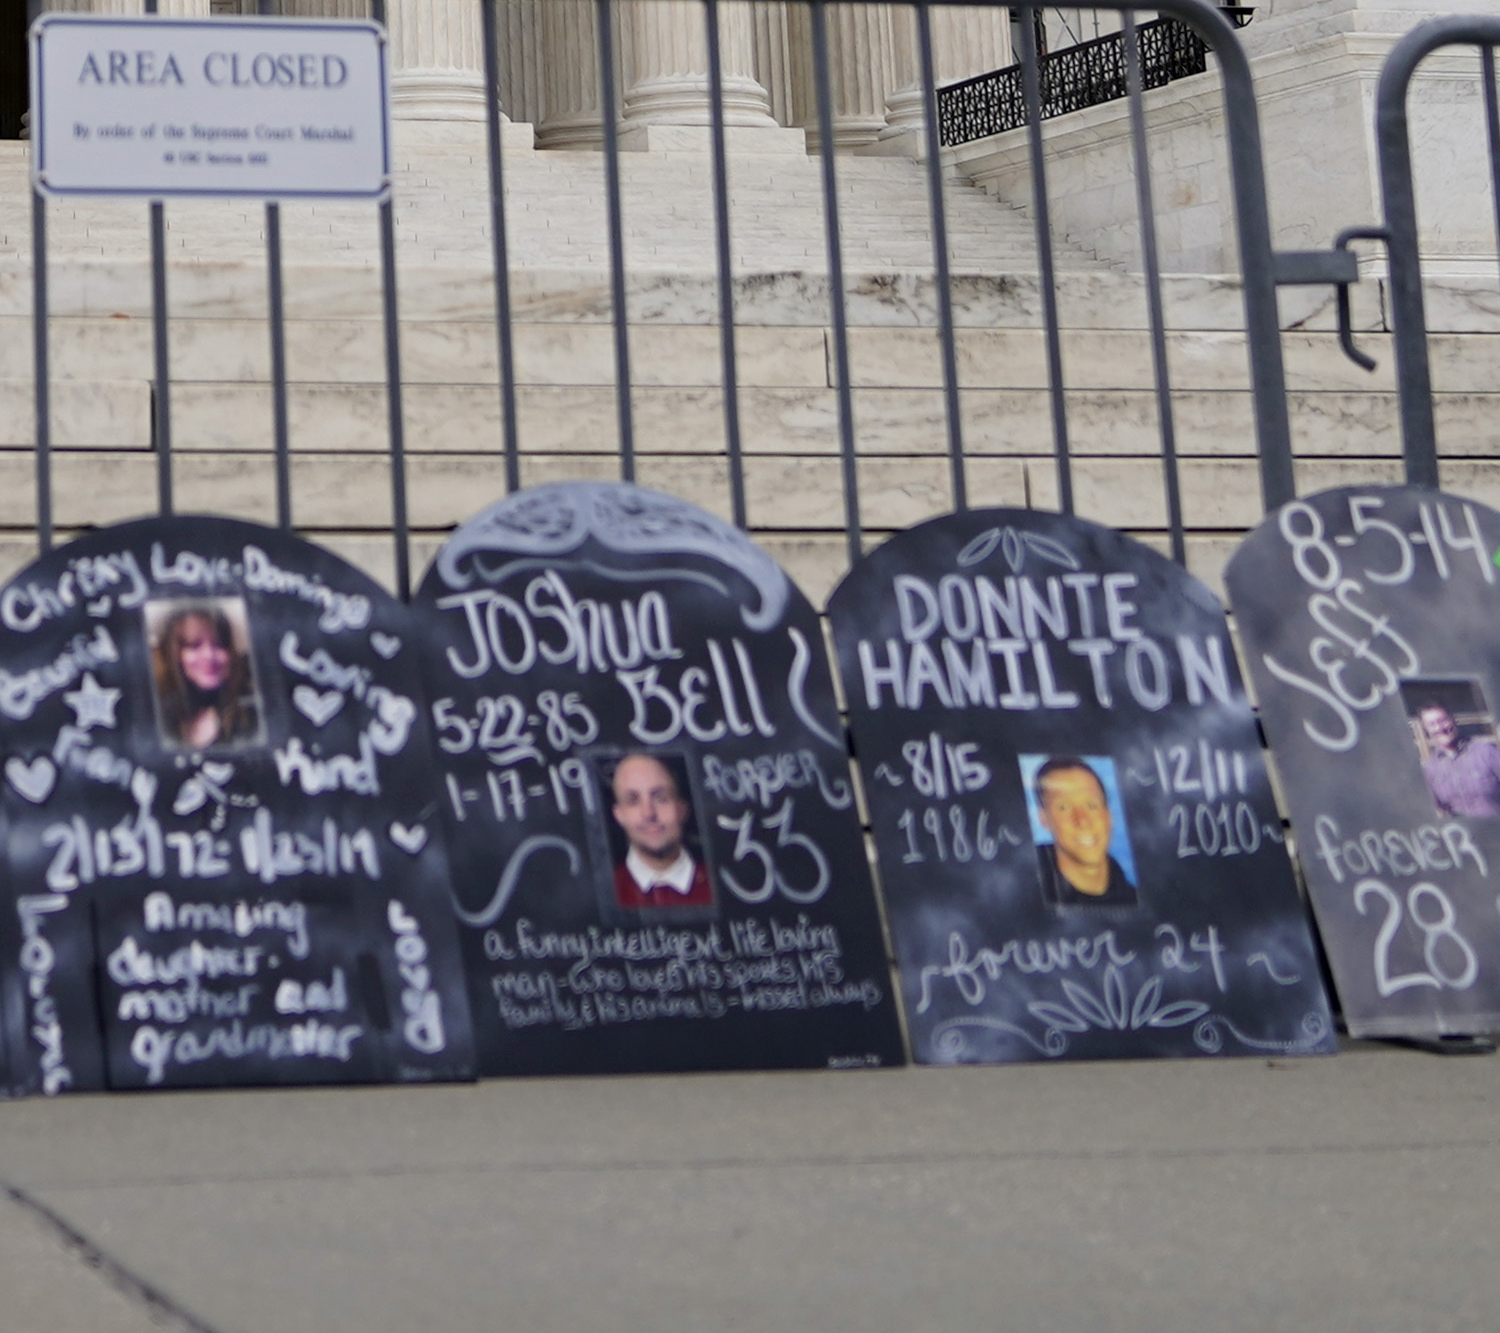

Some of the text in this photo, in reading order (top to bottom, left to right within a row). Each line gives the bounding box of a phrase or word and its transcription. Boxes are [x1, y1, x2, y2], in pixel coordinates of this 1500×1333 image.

[78, 50, 348, 88] AREA CLOSED
[856, 635, 1241, 711] HAMILTON
[716, 796, 831, 906] 33
[1154, 922, 1226, 993] 24
[1353, 878, 1478, 998] 28
